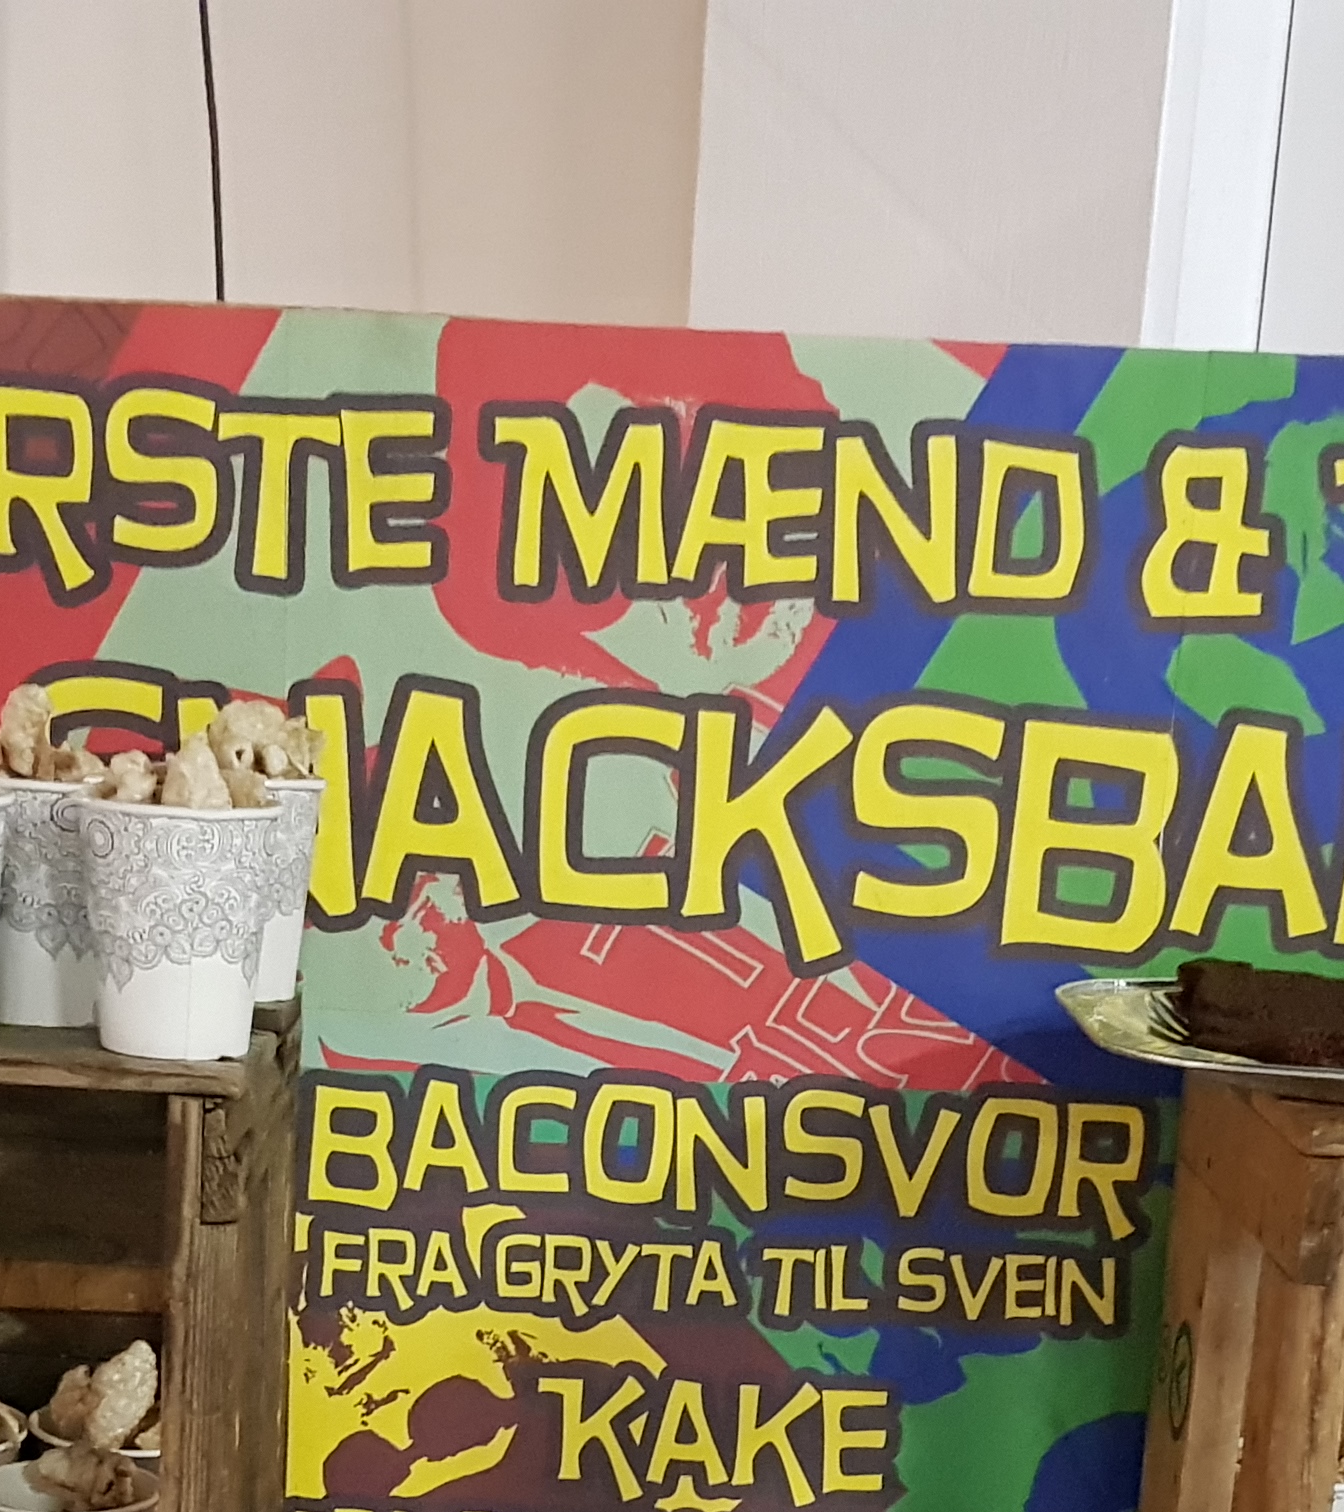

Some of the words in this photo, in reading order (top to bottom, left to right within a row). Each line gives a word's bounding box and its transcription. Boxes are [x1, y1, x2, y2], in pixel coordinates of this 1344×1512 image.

[494, 416, 1086, 604] MÆND
[1141, 445, 1270, 618] &
[307, 1080, 1146, 1240] BACONSVOR
[320, 1230, 468, 1312] FRA
[495, 1232, 737, 1317] GRYTA
[762, 1245, 868, 1316] TIL
[897, 1247, 1116, 1326] SVEIN
[538, 1377, 890, 1509] KAKE
